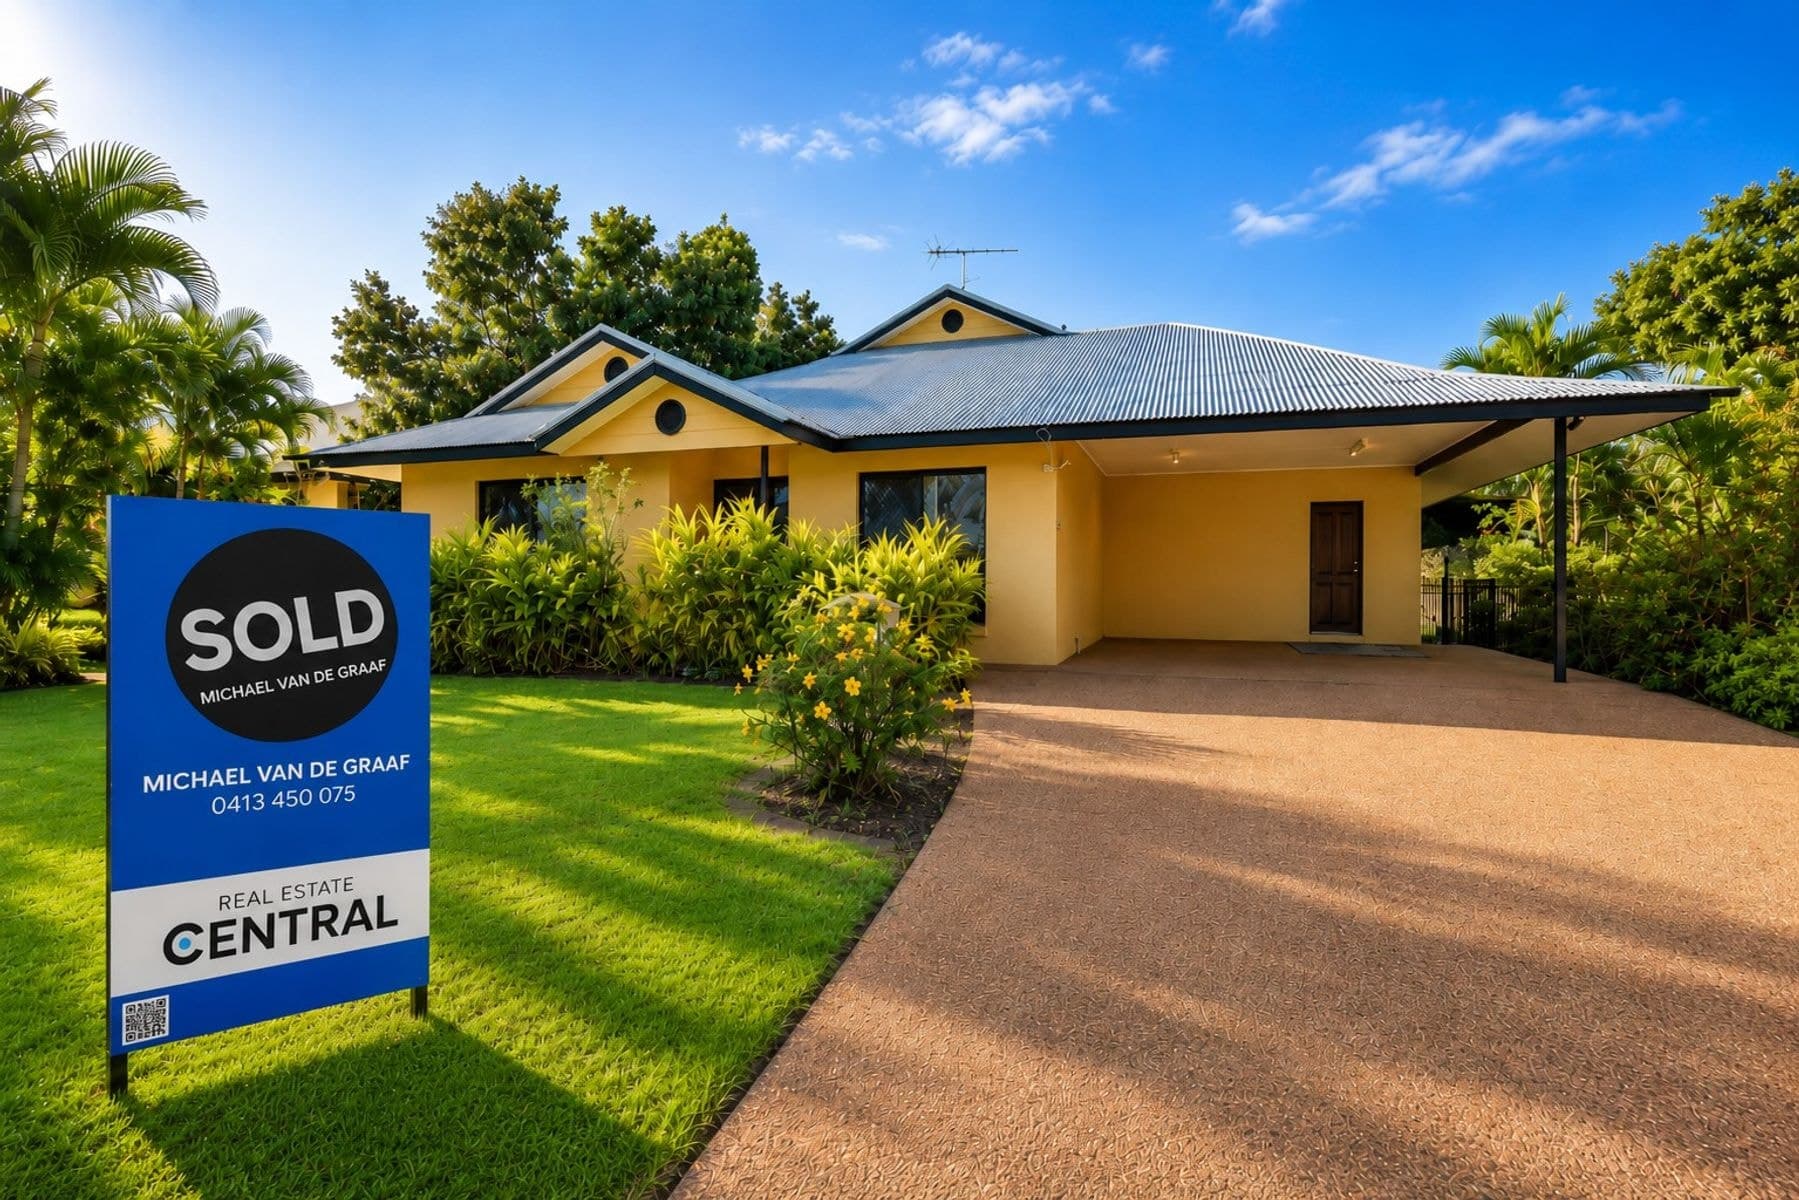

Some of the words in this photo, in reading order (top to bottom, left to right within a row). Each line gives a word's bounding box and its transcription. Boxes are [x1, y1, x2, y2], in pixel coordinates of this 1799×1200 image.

[180, 588, 385, 672] SOLD
[200, 680, 274, 705] MICHAEL
[276, 673, 311, 691] VAN
[314, 669, 335, 684] DE
[337, 659, 387, 679] GRAAF
[143, 767, 251, 793] MICHAEL
[257, 763, 303, 782] VAN
[310, 760, 337, 778] DE
[343, 754, 411, 775] GRAAF
[211, 793, 265, 815] 0413
[271, 788, 313, 809] 450
[319, 784, 356, 805] 075
[218, 889, 273, 911] REAL
[281, 876, 354, 901] ESTATE
[162, 894, 399, 966] CENTRAL
